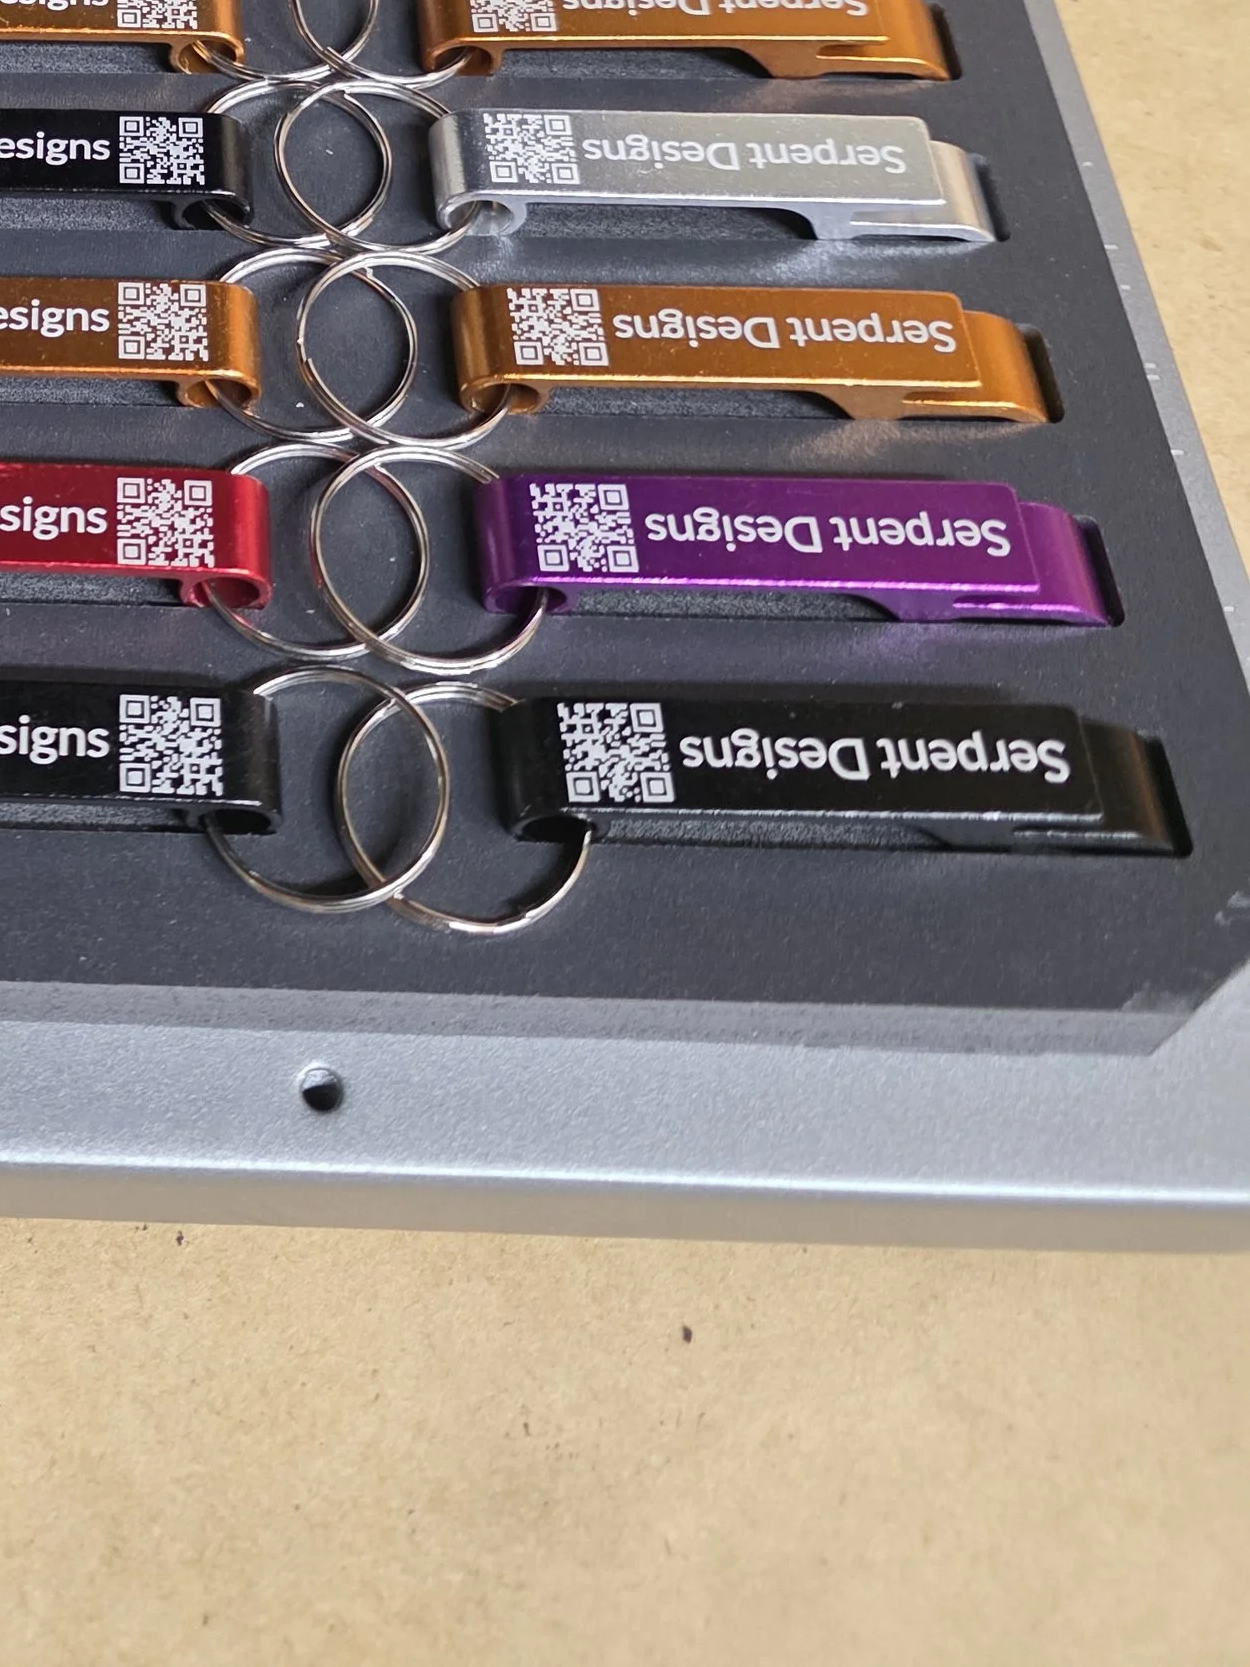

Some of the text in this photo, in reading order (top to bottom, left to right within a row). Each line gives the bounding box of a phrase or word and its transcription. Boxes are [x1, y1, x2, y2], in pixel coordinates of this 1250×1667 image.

[582, 134, 906, 173] Serpent Designs
[613, 309, 956, 352] Serpent Designs
[645, 507, 1010, 556] Serpent Designs
[680, 728, 1070, 783] Serpent Designs
